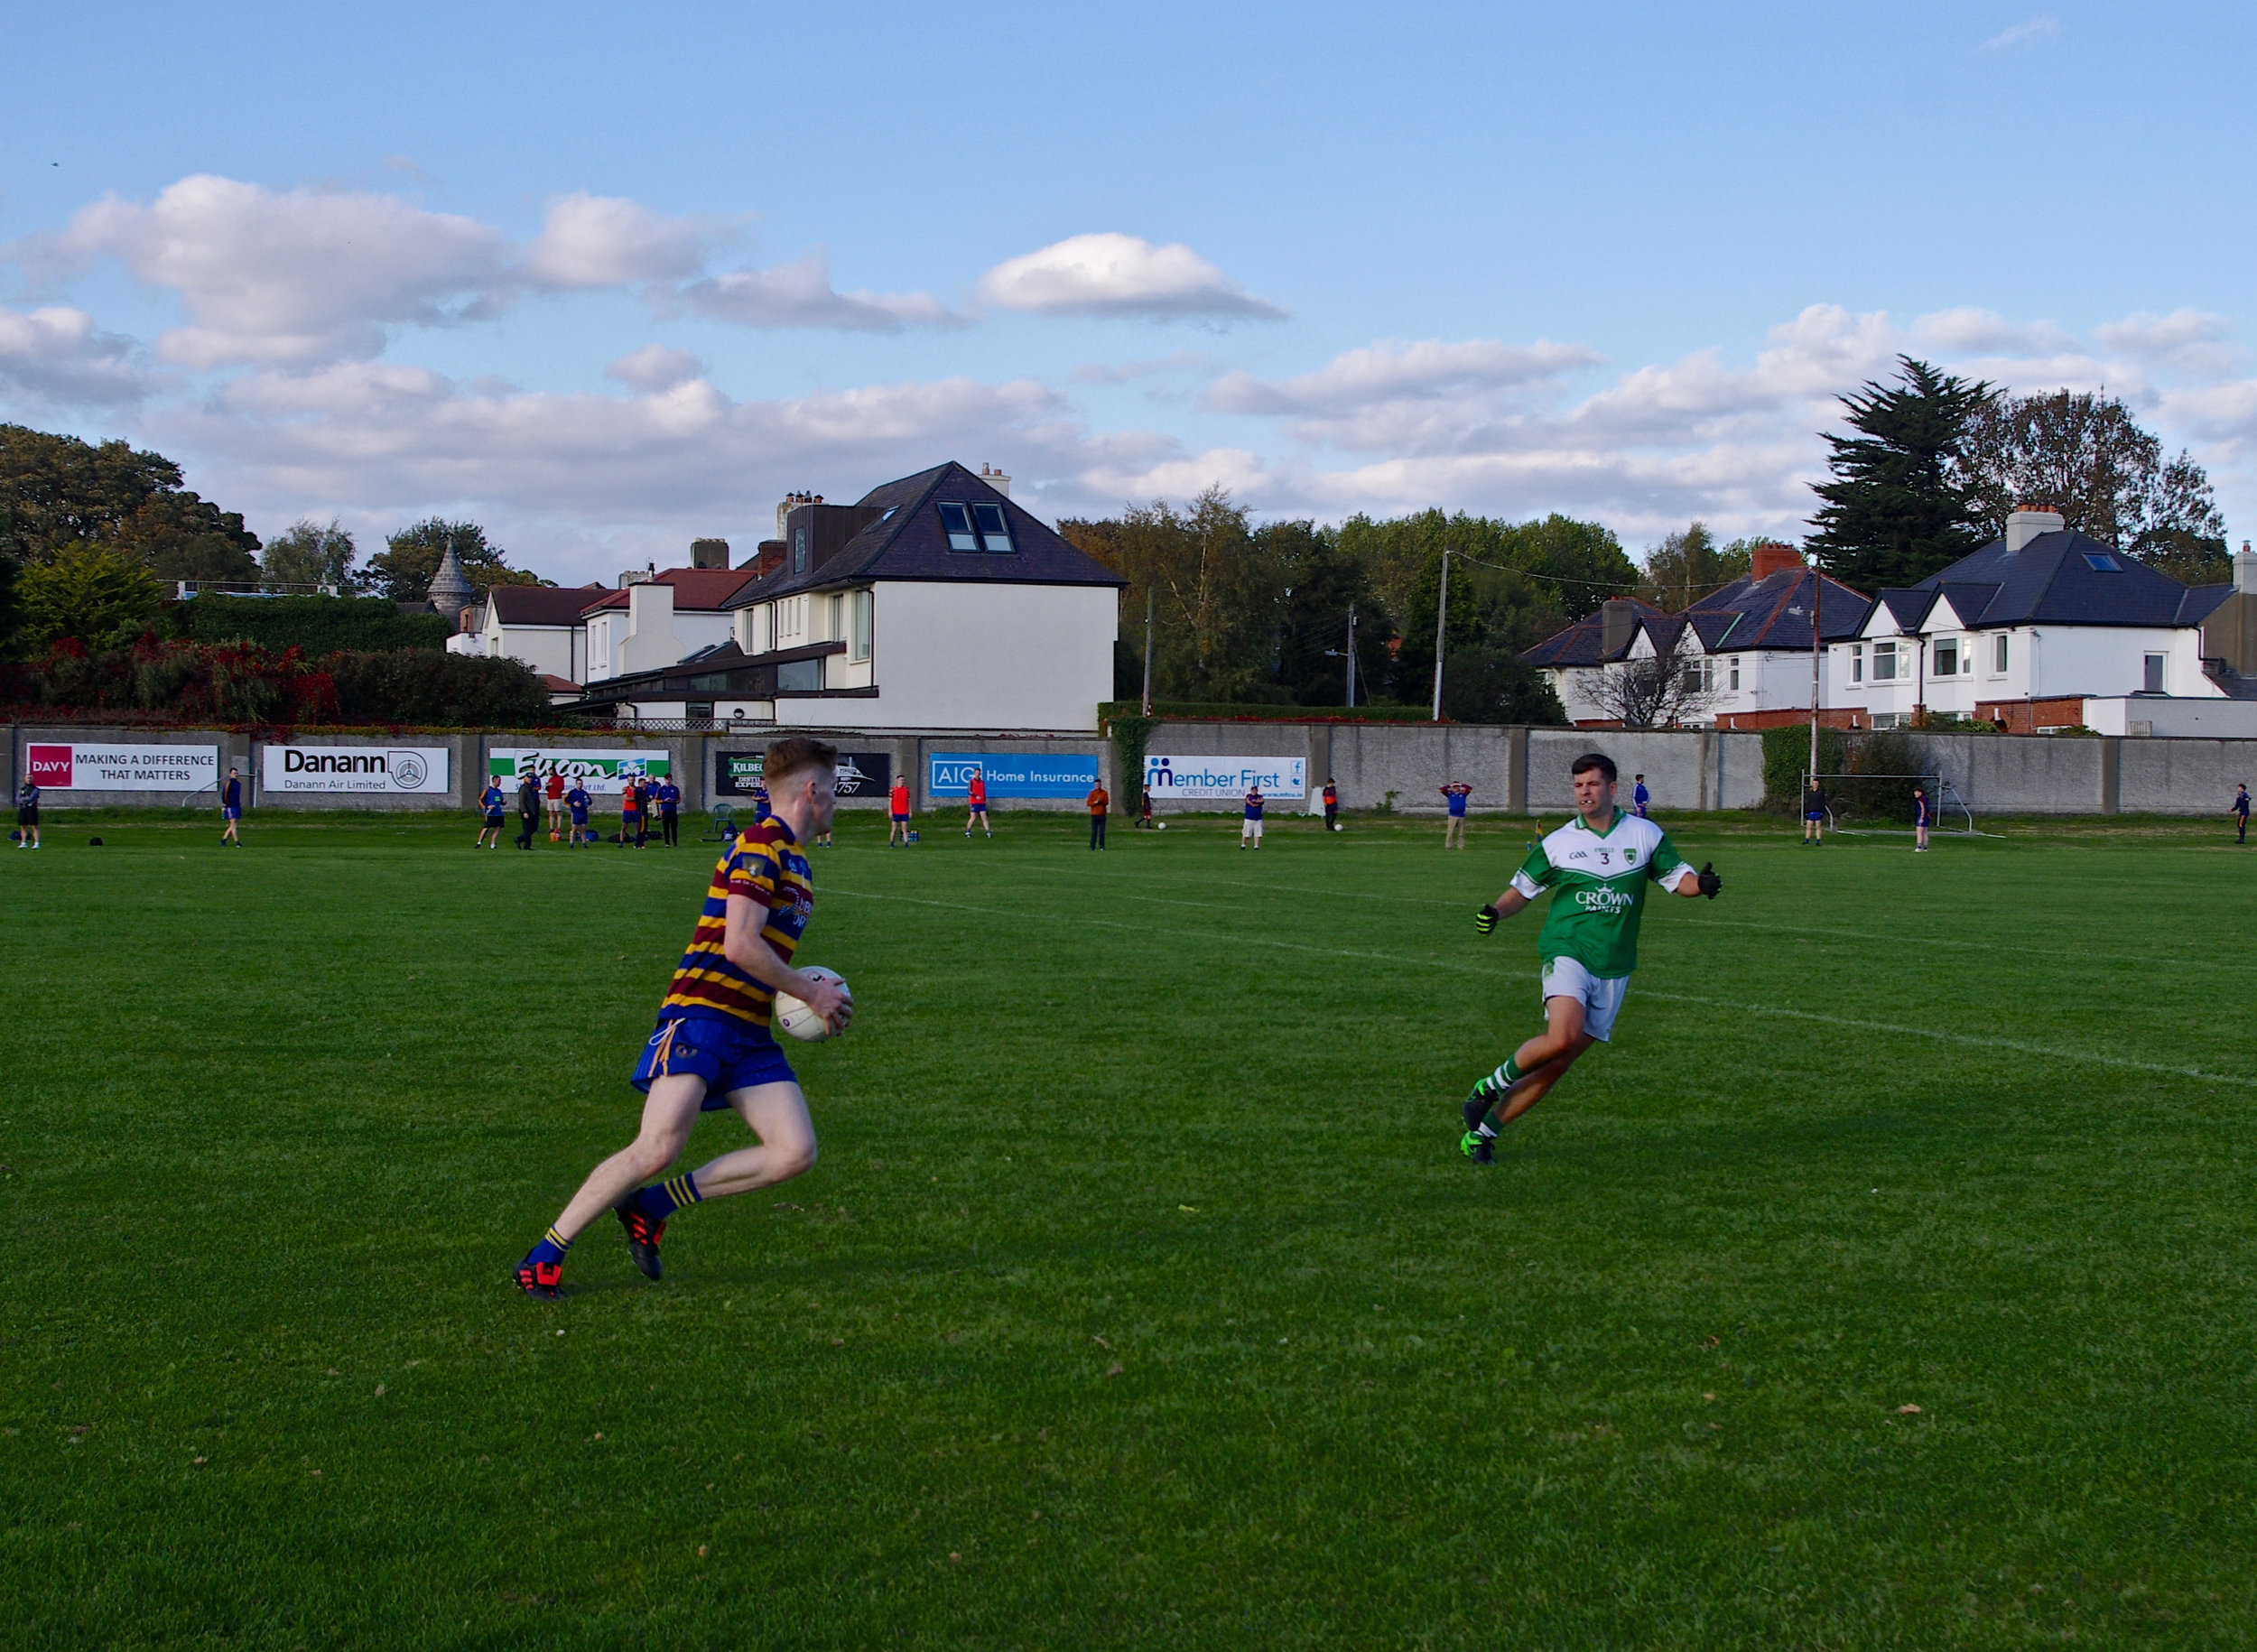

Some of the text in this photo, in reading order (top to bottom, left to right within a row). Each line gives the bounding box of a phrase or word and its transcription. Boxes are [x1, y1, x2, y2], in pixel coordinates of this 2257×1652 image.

[75, 754, 214, 766] MAKING A DIFFERENCE
[284, 749, 385, 773] Danann
[514, 750, 617, 780] Eucon
[33, 761, 70, 772] DAVY
[100, 769, 190, 781] THAT MATTERS
[938, 766, 976, 783] AIG
[986, 770, 1095, 783] Home Insurance
[1240, 769, 1280, 788] First
[284, 779, 385, 789] Danann Air Limited
[1182, 788, 1246, 797] CREDIT UNION
[1601, 853, 1610, 865] 3
[1575, 891, 1634, 906] CROWN
